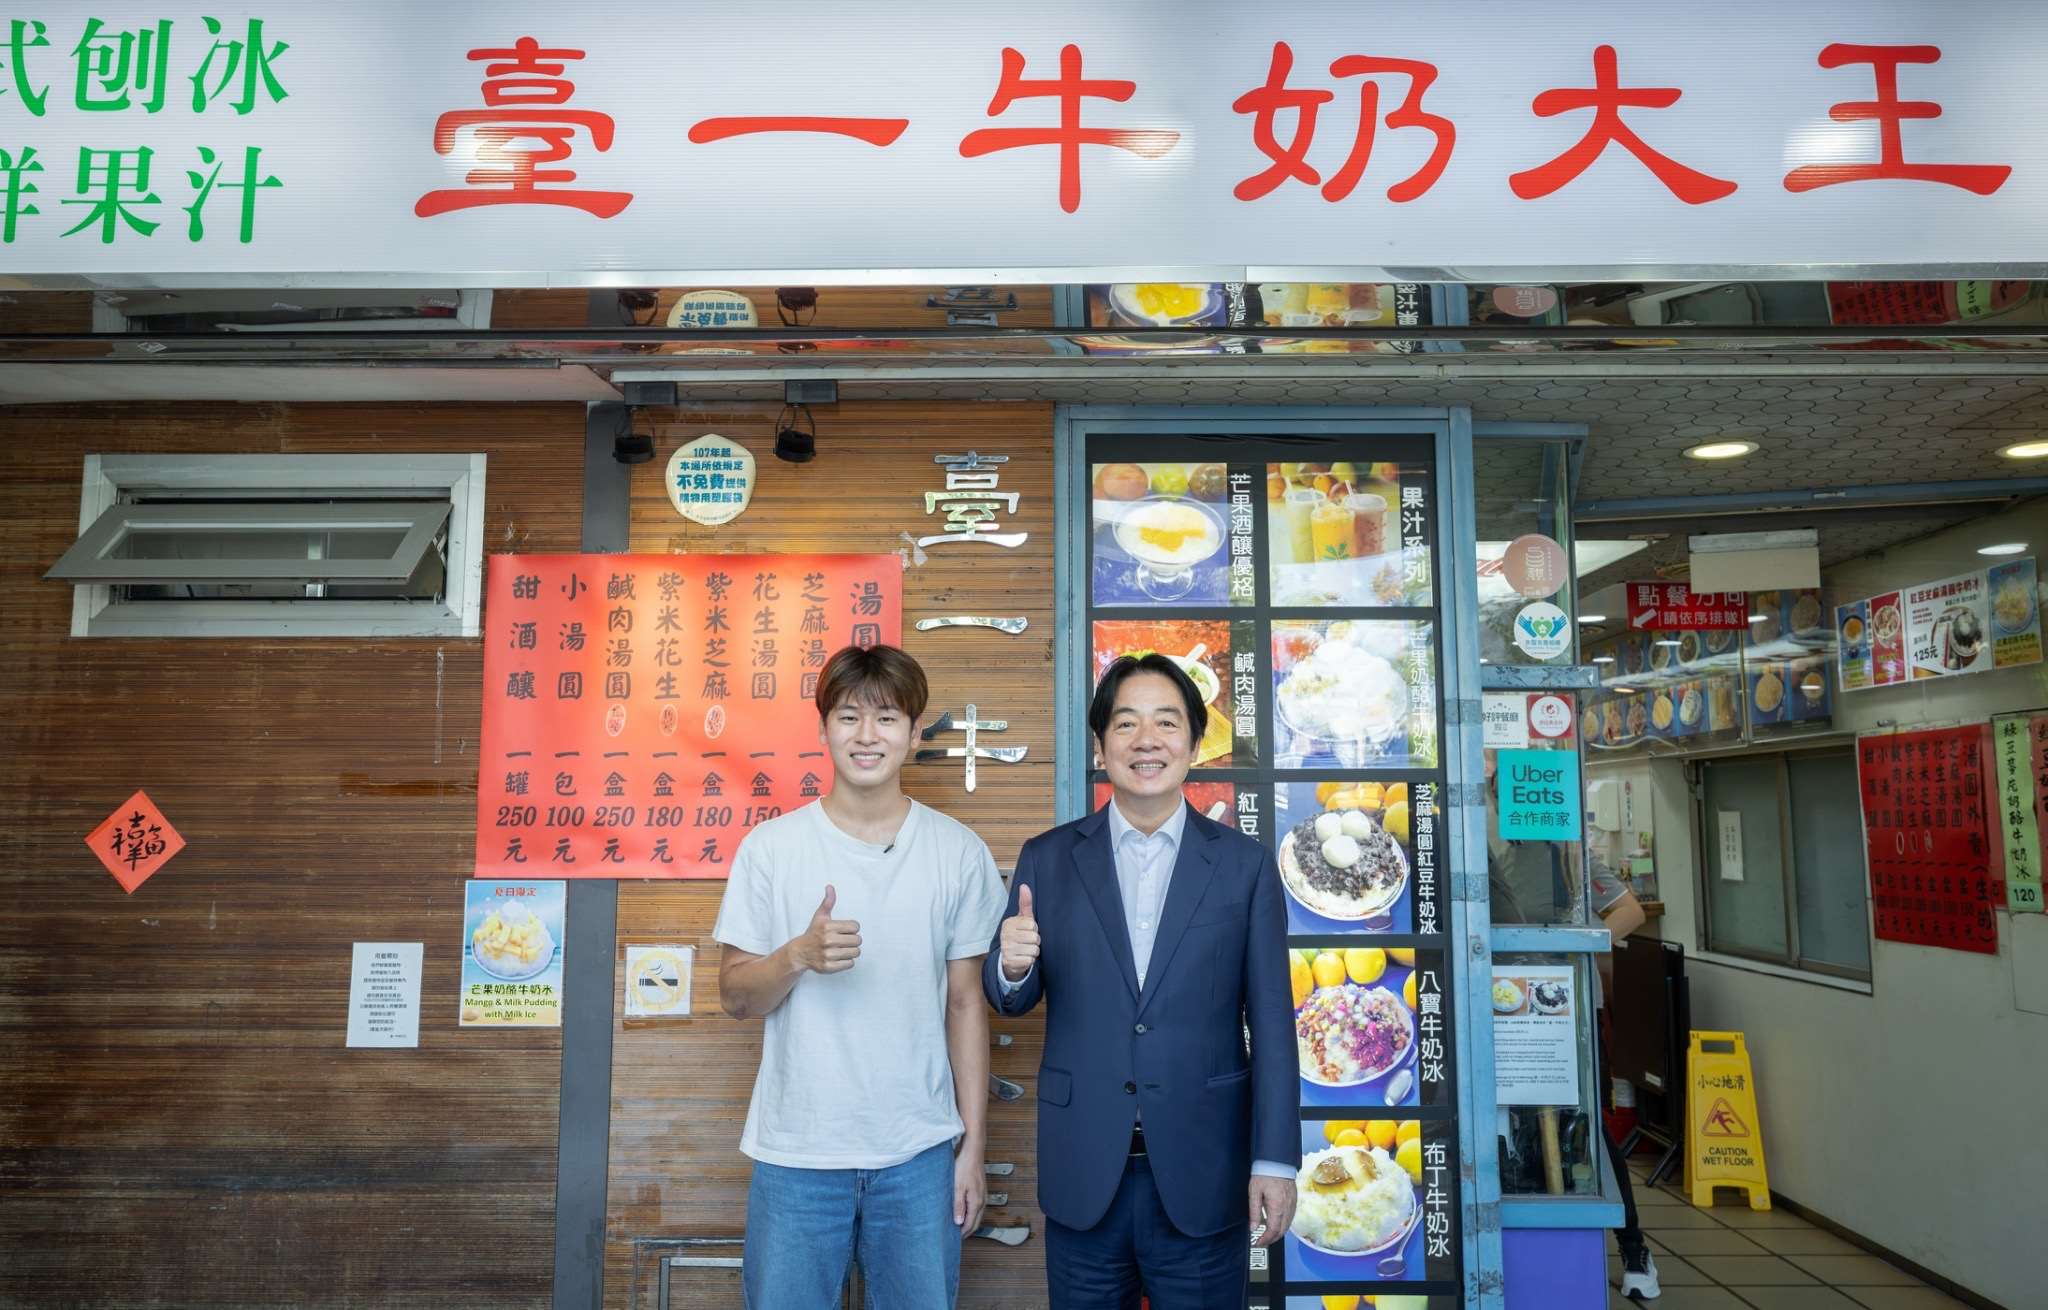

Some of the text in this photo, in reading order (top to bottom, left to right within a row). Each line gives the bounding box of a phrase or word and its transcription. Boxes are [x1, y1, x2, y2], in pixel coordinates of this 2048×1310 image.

[414, 36, 2013, 218] 臺一牛奶大王
[1230, 473, 1254, 597] 芒果酒釀優格
[1402, 487, 1426, 583] 果汁系列
[506, 574, 541, 700] 甜酒釀
[557, 573, 588, 700] 小湯圓
[602, 572, 637, 700] 鹹肉湯圓
[653, 572, 686, 700] 紫米花生
[702, 571, 733, 700] 紫米芝麻
[751, 571, 781, 700] 花生湯圓
[1663, 611, 1739, 625] 請依序排隊
[1234, 652, 1256, 737] 鹹肉湯圓
[1238, 792, 1260, 836] 紅豆
[1508, 811, 1571, 826] 合作商家
[1512, 765, 1564, 783] Uber
[1513, 786, 1565, 805] Eats
[1415, 784, 1437, 935] 芝麻湯圓紅豆牛奶冰
[2013, 888, 2035, 902] 120
[465, 999, 493, 1008] Mango
[505, 998, 522, 1006] Milk
[524, 998, 558, 1007] Pudding
[484, 1010, 503, 1018] with
[504, 1010, 523, 1018] Milk
[1419, 971, 1445, 1083] 八寶牛奶冰
[1698, 1074, 1745, 1091] 小心地滑
[1702, 1156, 1755, 1166] WET FLOOR
[1708, 1146, 1748, 1156] CAUTION
[1424, 1143, 1451, 1258] 布丁牛奶冰
